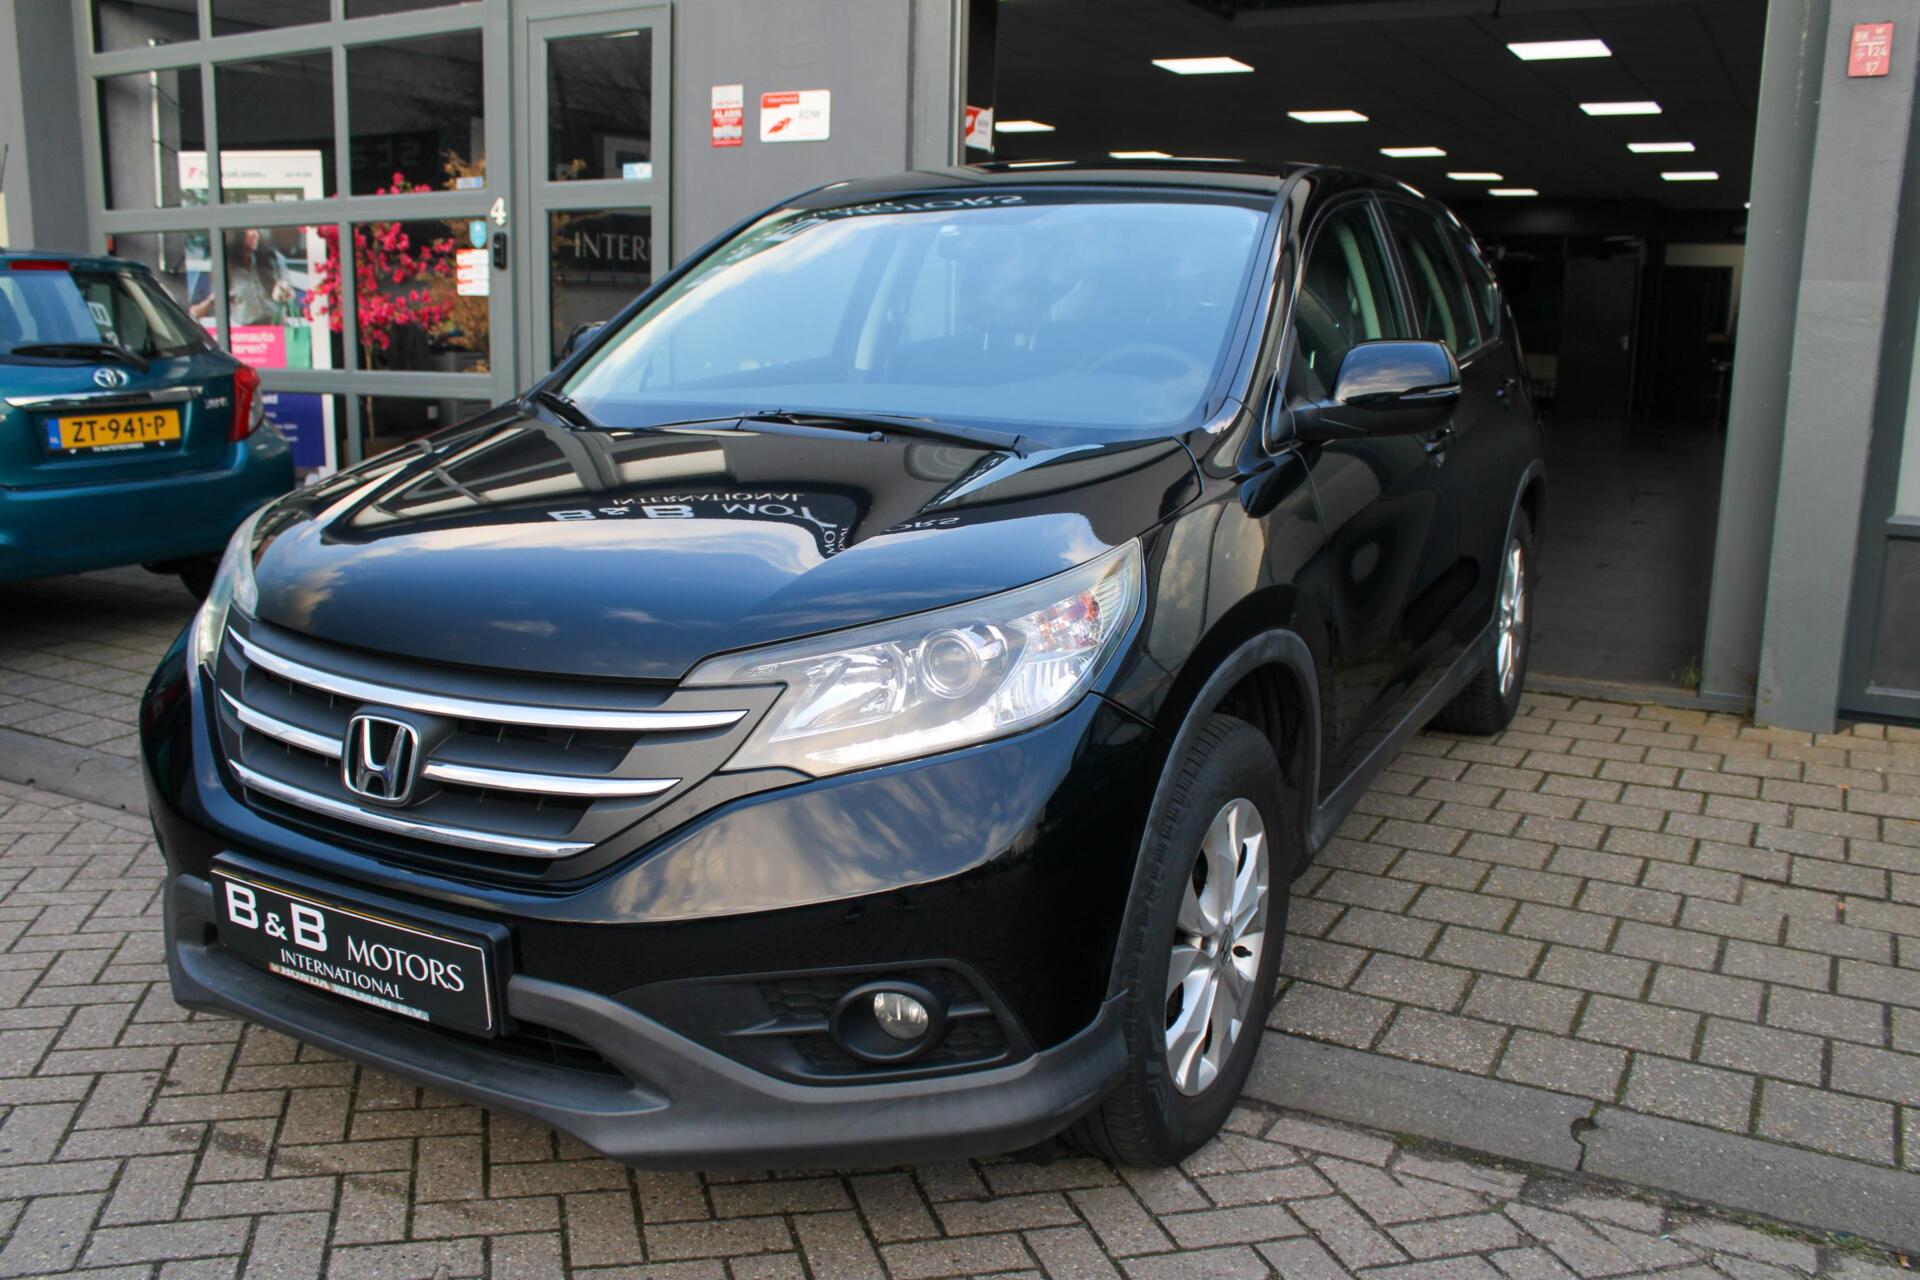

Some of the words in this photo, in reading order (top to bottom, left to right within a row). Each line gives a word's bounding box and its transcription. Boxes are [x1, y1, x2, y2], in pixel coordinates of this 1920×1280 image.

[490, 197, 507, 226] 4
[574, 231, 651, 261] INTER
[71, 415, 166, 443] ZT-941-P
[280, 949, 404, 1001] INTERNATIONAL
[347, 935, 465, 992] MOTORS
